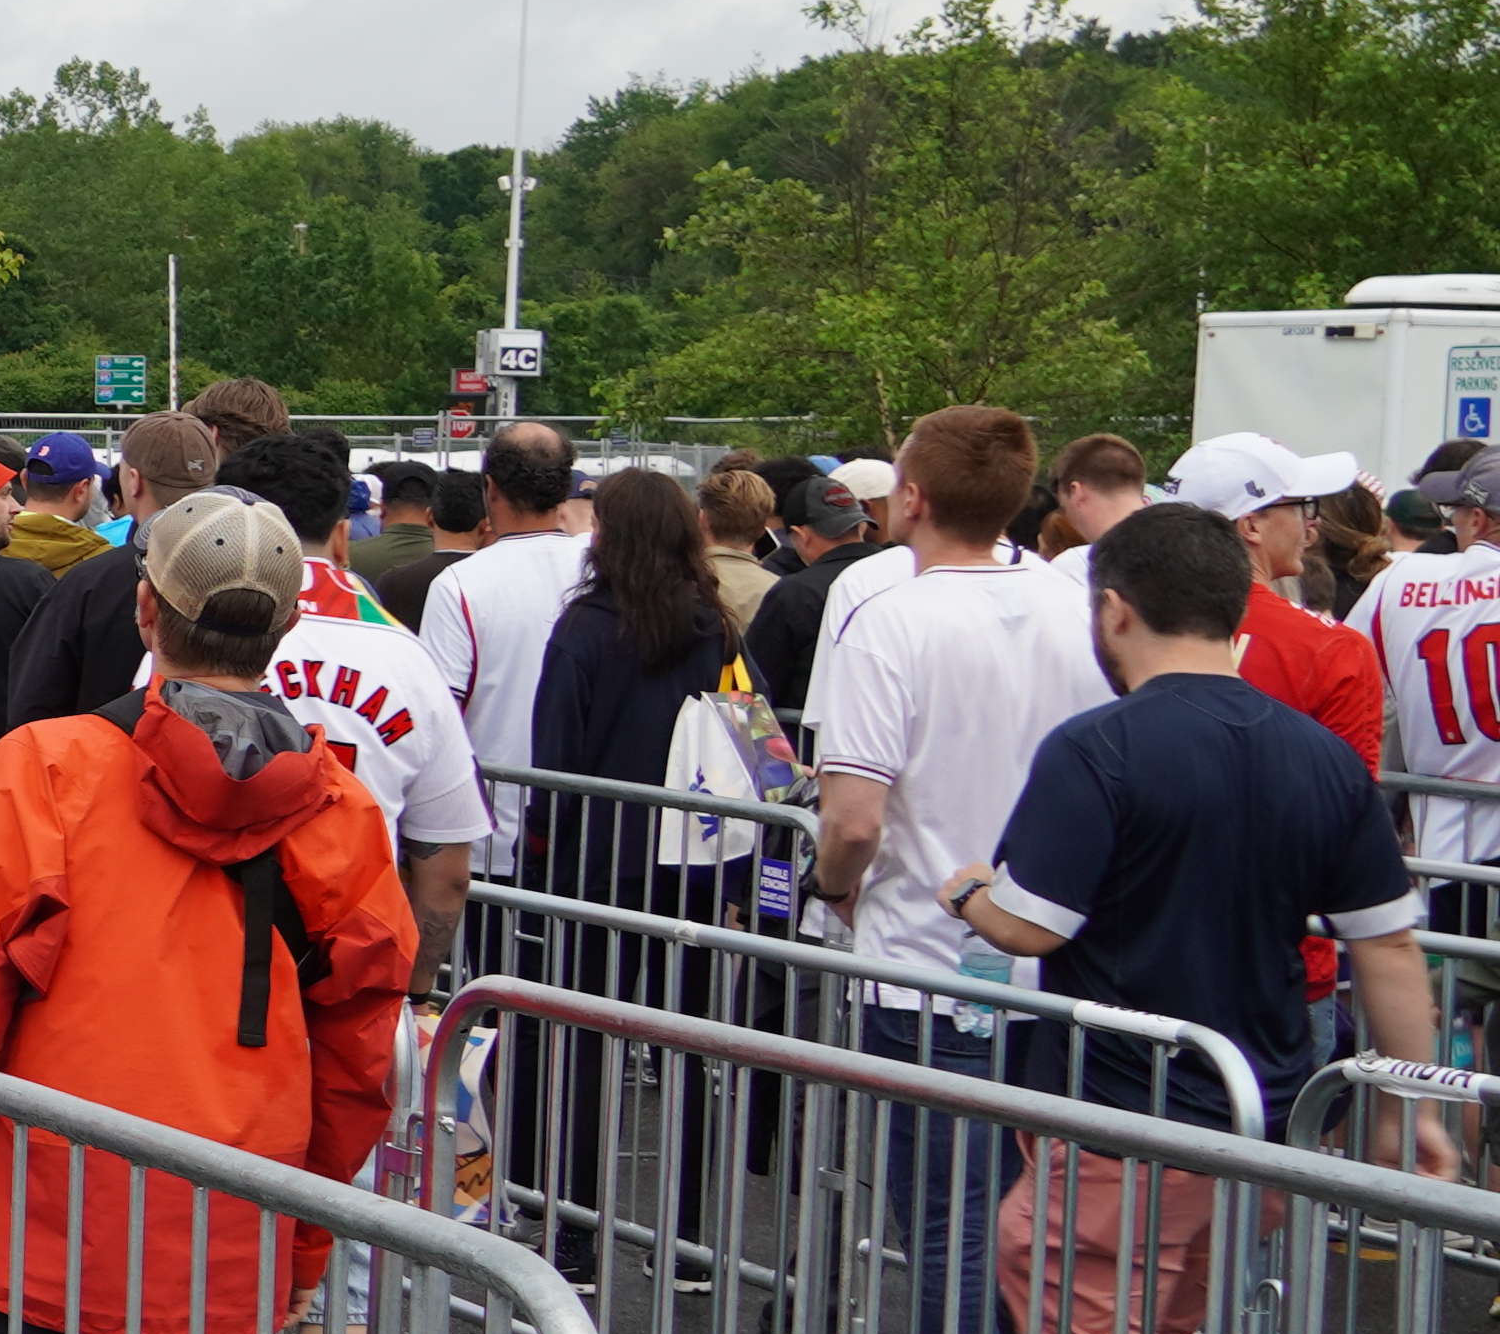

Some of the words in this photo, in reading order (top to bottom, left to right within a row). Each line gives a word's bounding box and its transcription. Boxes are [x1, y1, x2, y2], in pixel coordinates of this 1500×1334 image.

[501, 349, 537, 370] 4C
[1455, 376, 1497, 391] PARKING
[1417, 622, 1500, 746] 10
